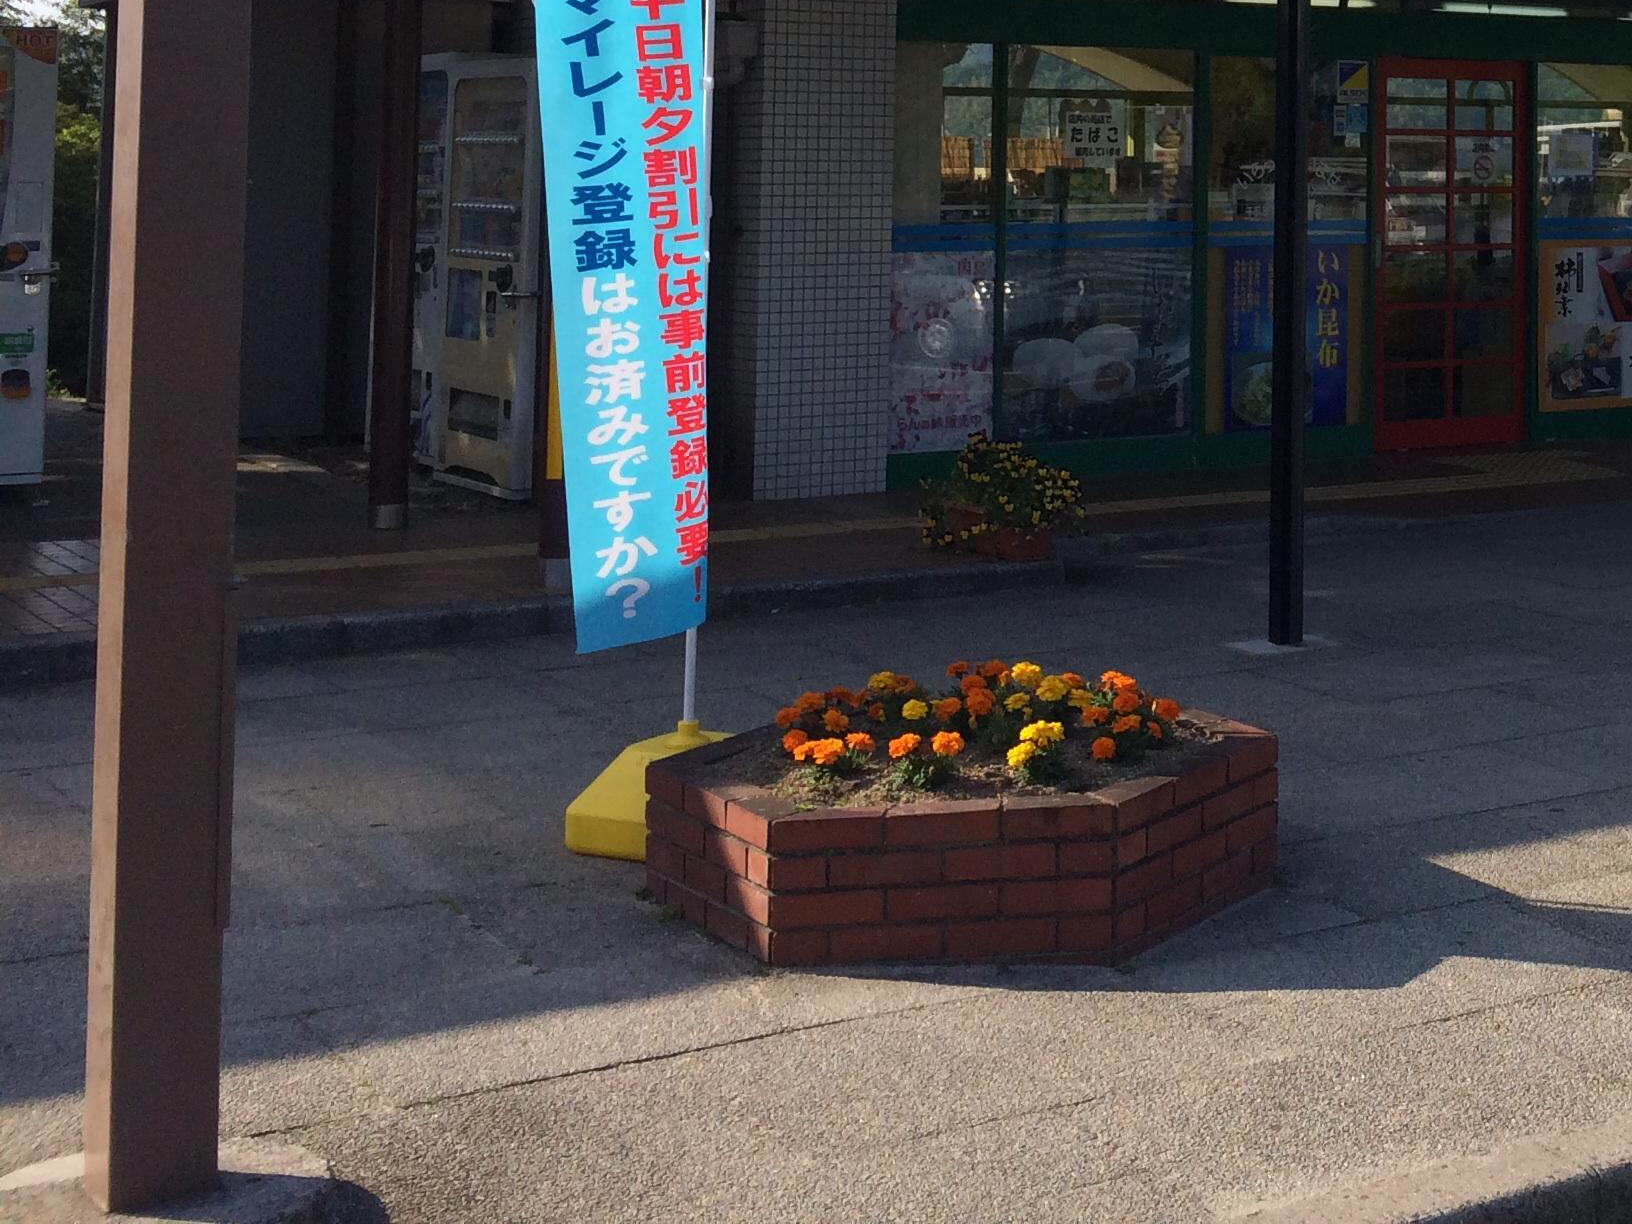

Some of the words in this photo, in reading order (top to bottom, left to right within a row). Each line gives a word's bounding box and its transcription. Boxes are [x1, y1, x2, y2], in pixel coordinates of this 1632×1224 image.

[1070, 127, 1119, 143] たばこ
[1315, 249, 1341, 369] いか昆布
